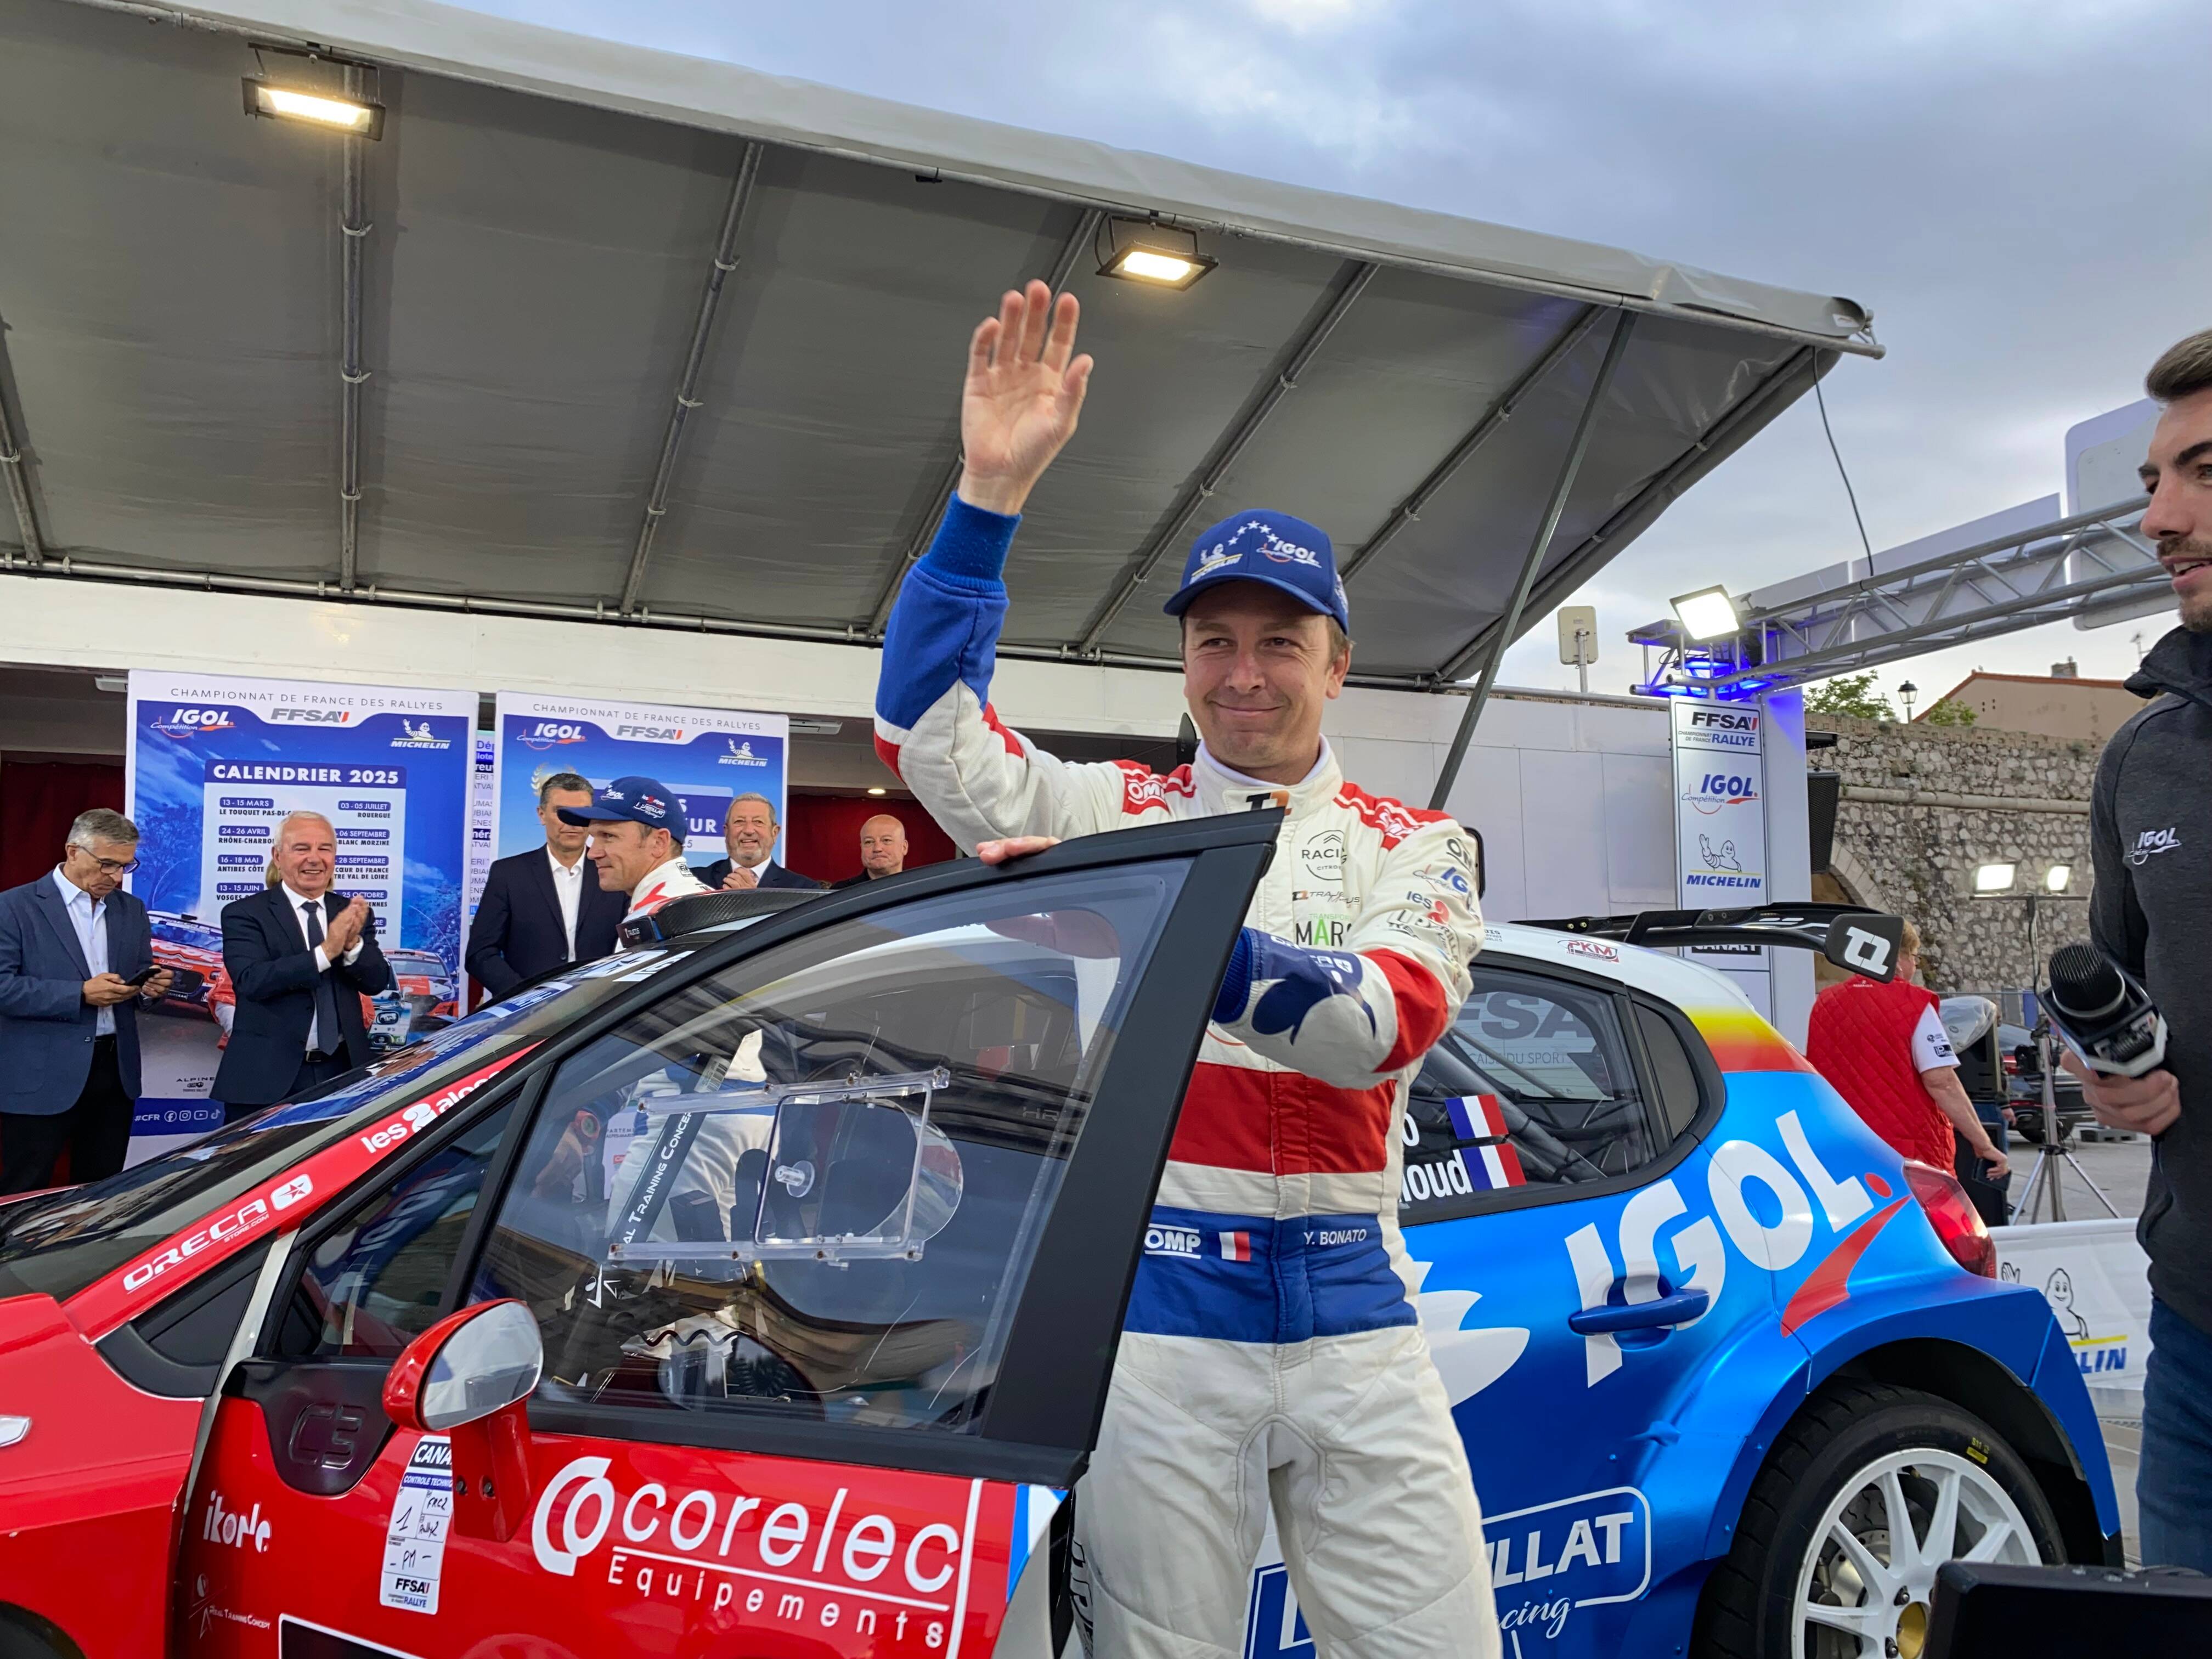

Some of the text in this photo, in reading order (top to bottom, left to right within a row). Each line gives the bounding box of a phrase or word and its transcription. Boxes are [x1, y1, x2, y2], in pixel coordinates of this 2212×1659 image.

[1273, 540, 1319, 564] IGOL
[171, 688, 274, 701] CHAMPIONNAT
[280, 694, 297, 703] DE
[303, 695, 354, 706] FRANCE
[391, 700, 443, 710] RALLYES
[270, 708, 342, 723] FFSA
[533, 703, 760, 730] CHAMPIONNAT DE FRANCE DES RALLYES
[1691, 712, 1751, 731] FFSA
[150, 721, 198, 731] Compétition
[616, 724, 677, 740] FFSA
[390, 741, 450, 749] MICHELIN
[517, 735, 556, 743] Compétition
[1711, 733, 1756, 747] RALLYE
[718, 758, 767, 768] MICHELIN
[213, 765, 399, 785] CALENDRIER 2025
[1681, 792, 1725, 805] Compétition
[685, 818, 718, 833] UR
[2137, 827, 2176, 849] IGOL
[248, 864, 264, 872] CÔTE
[1686, 874, 1762, 888] MICHELIN
[1295, 918, 1352, 947] MAR
[1567, 940, 1613, 956] PKM
[134, 1114, 160, 1122] #CFR
[360, 1119, 408, 1154] les
[628, 1161, 668, 1229] TRAINING
[223, 1213, 269, 1244] STORE.COM
[623, 1227, 636, 1245] AL
[1303, 1228, 1367, 1245] Y. BONATO
[122, 1198, 268, 1291] ORECA
[1144, 1229, 1201, 1254] OMP
[2075, 1347, 2127, 1374] LIN
[403, 1475, 431, 1485] CONTROLE
[396, 1506, 413, 1531] 1
[622, 1482, 960, 1594] corelec
[395, 1577, 426, 1594] FFSA
[403, 1596, 427, 1608] RALLYE
[607, 1554, 944, 1648] Equipements
[1496, 1597, 1572, 1639] cing
